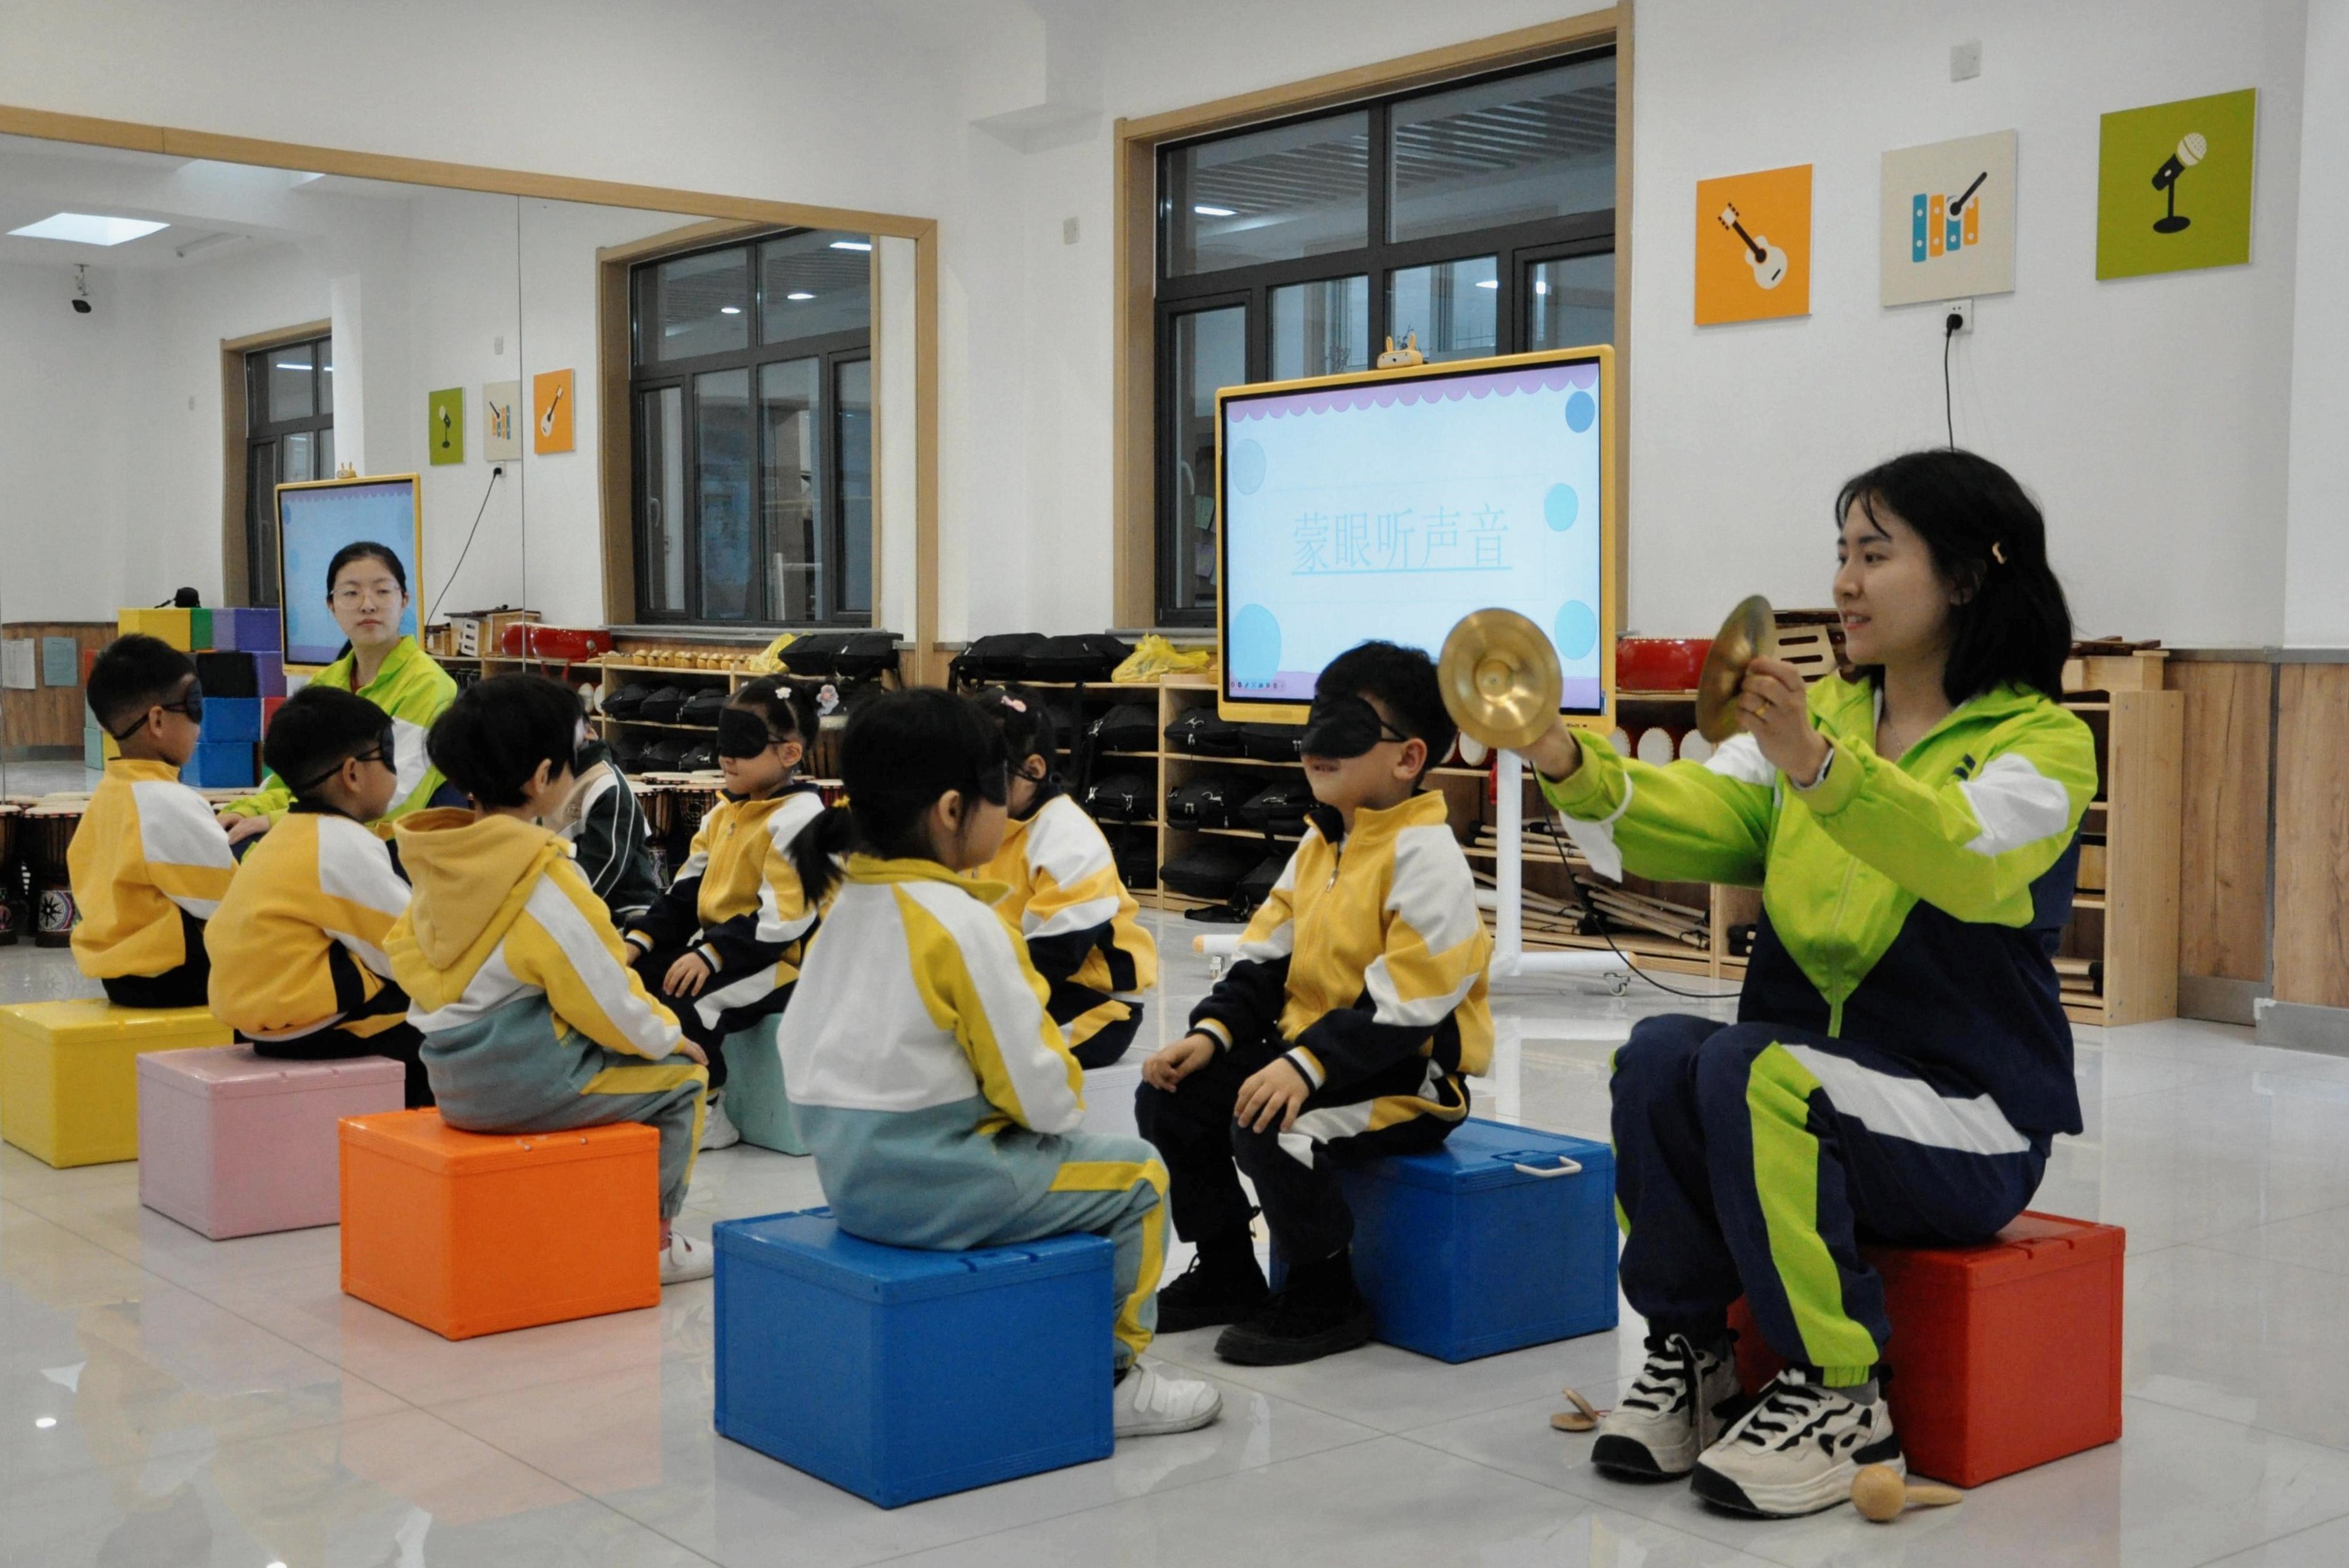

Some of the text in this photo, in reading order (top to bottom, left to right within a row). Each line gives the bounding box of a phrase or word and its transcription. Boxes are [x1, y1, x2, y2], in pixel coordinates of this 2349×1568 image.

[1293, 503, 1510, 572] 蒙眼听声音
